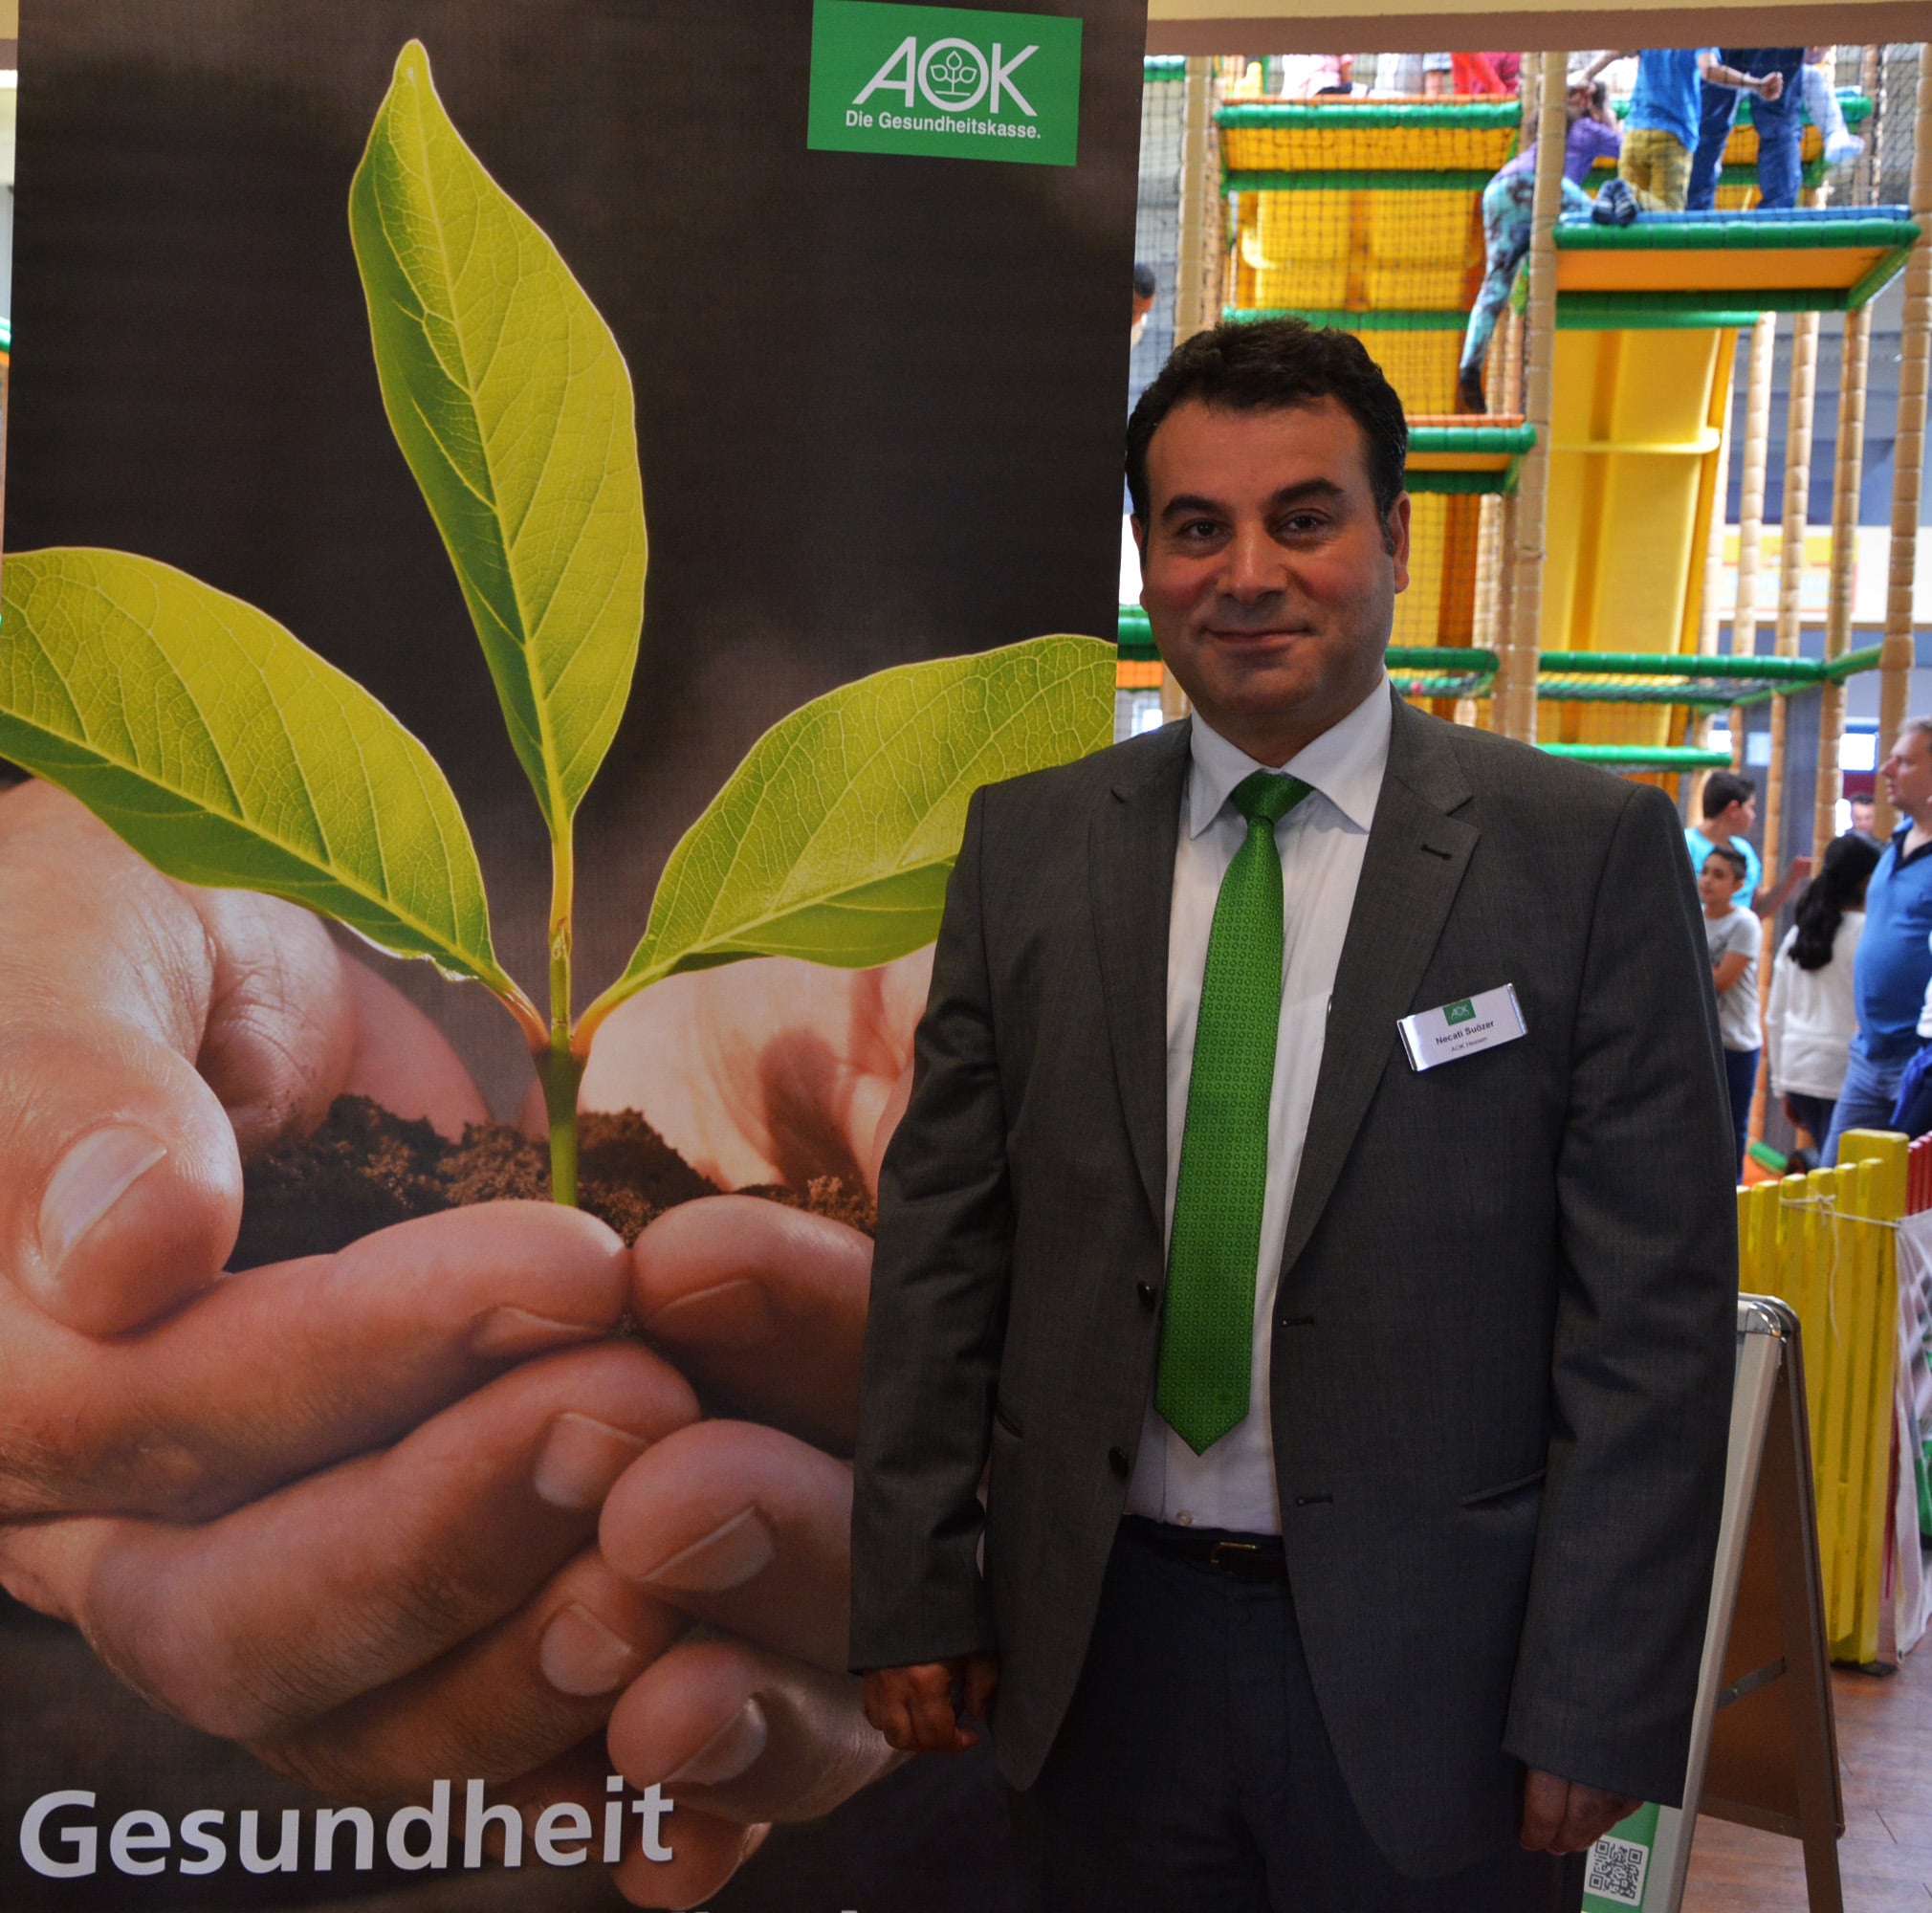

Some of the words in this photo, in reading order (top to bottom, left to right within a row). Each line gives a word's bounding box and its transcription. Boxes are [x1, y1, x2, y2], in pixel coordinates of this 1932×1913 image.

[851, 36, 1040, 117] AOK
[845, 109, 873, 128] Die
[878, 112, 1042, 140] Gesundheitskasse.
[1435, 1029, 1463, 1045] Necati
[19, 1775, 674, 1879] Gesundheit
